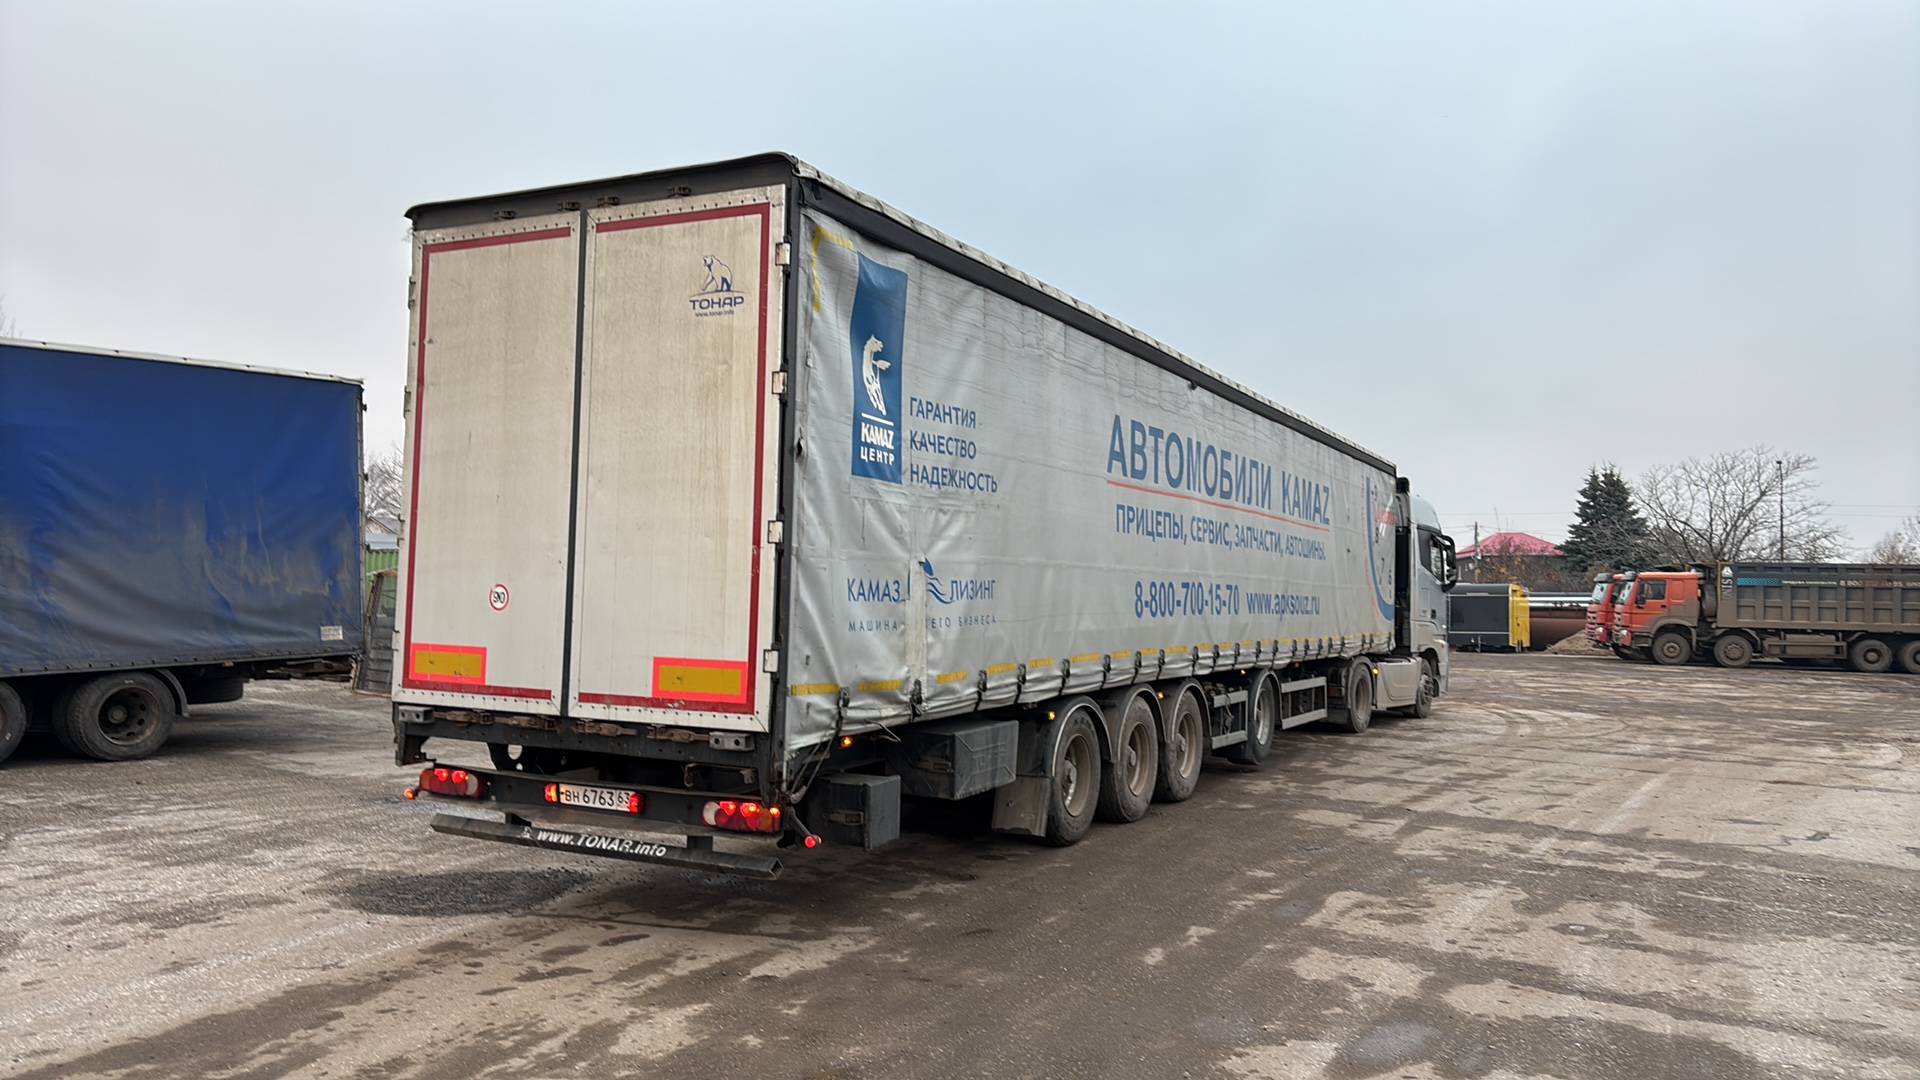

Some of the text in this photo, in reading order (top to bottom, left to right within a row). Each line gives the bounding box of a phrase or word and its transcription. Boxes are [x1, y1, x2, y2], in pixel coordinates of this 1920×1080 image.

[688, 296, 745, 310] ТОНАР
[910, 397, 977, 429] ГАРАНТИЯ
[861, 422, 895, 450] KAMAZ
[910, 430, 977, 461] КАЧЕСТВО
[860, 446, 895, 466] ЦЕНТР
[1106, 414, 1330, 525] АВТОМОБИЛИ KAMAZ
[910, 463, 998, 493] НАДЕЖНОСТЬ
[1116, 503, 1188, 546] ПРИЦЕПЫ,
[1190, 515, 1232, 552] СЕРВИС,
[1234, 523, 1284, 558] ЗАПЧАСТИ,
[847, 578, 996, 602] КАМАЗ ЛИЗИНГ
[1135, 581, 1240, 618] 8-800-700-15-70
[848, 620, 899, 633] МАШИНА
[958, 614, 997, 627] БИЗНЕСА
[582, 788, 614, 807] 6763
[537, 830, 667, 857] www.TONAR.info
